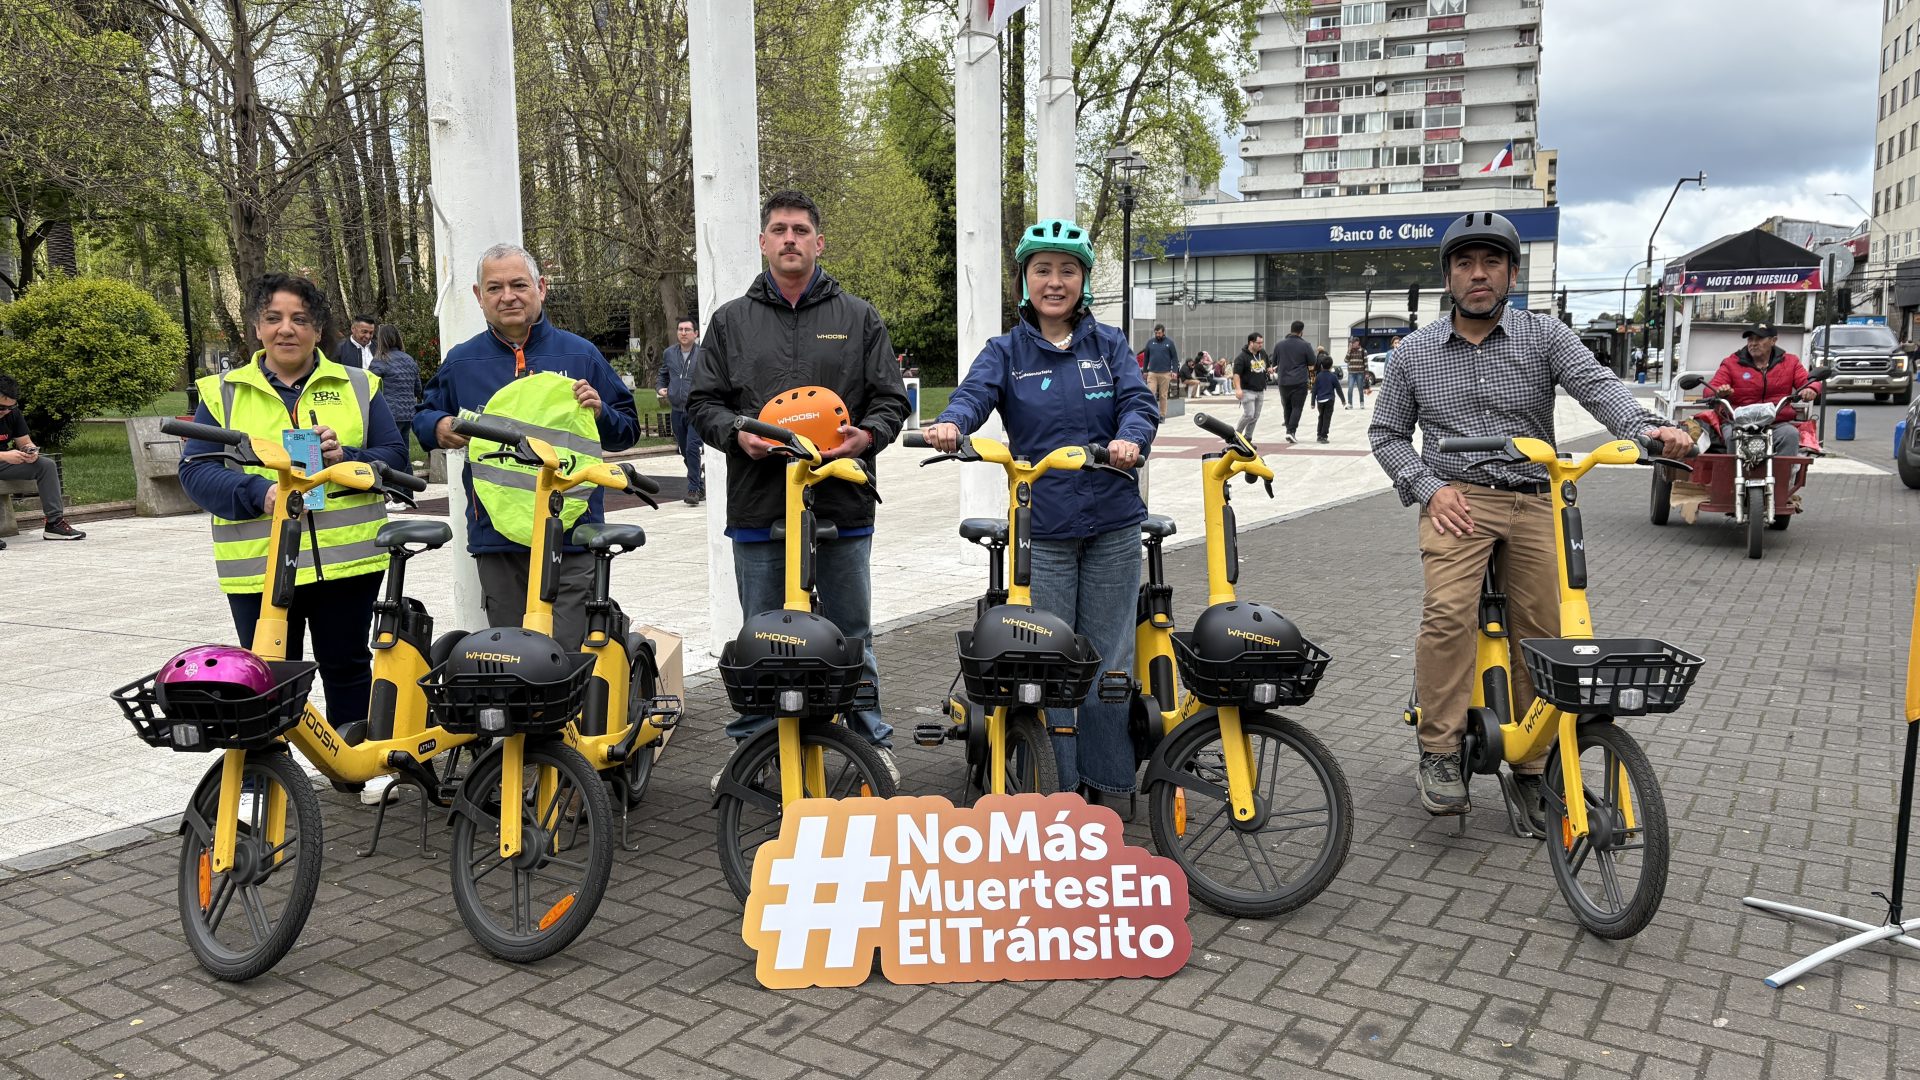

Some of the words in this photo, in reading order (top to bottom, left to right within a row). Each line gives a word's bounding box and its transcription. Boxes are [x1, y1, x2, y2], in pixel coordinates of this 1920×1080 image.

[1329, 225, 1374, 242] Banco
[1379, 225, 1393, 240] de
[1398, 223, 1434, 240] Chile
[1706, 276, 1732, 286] MOTE
[1733, 275, 1754, 286] CON
[1755, 273, 1799, 285] HUESILLO
[777, 411, 820, 425] WHOOSH
[1002, 616, 1053, 637] WHOOSH
[755, 631, 807, 646] WHOOSH
[1227, 627, 1280, 647] WHOOSH
[465, 651, 521, 664] WHOOSH
[898, 864, 1172, 913] MuertesEn
[898, 914, 1175, 966] ElTránsito
